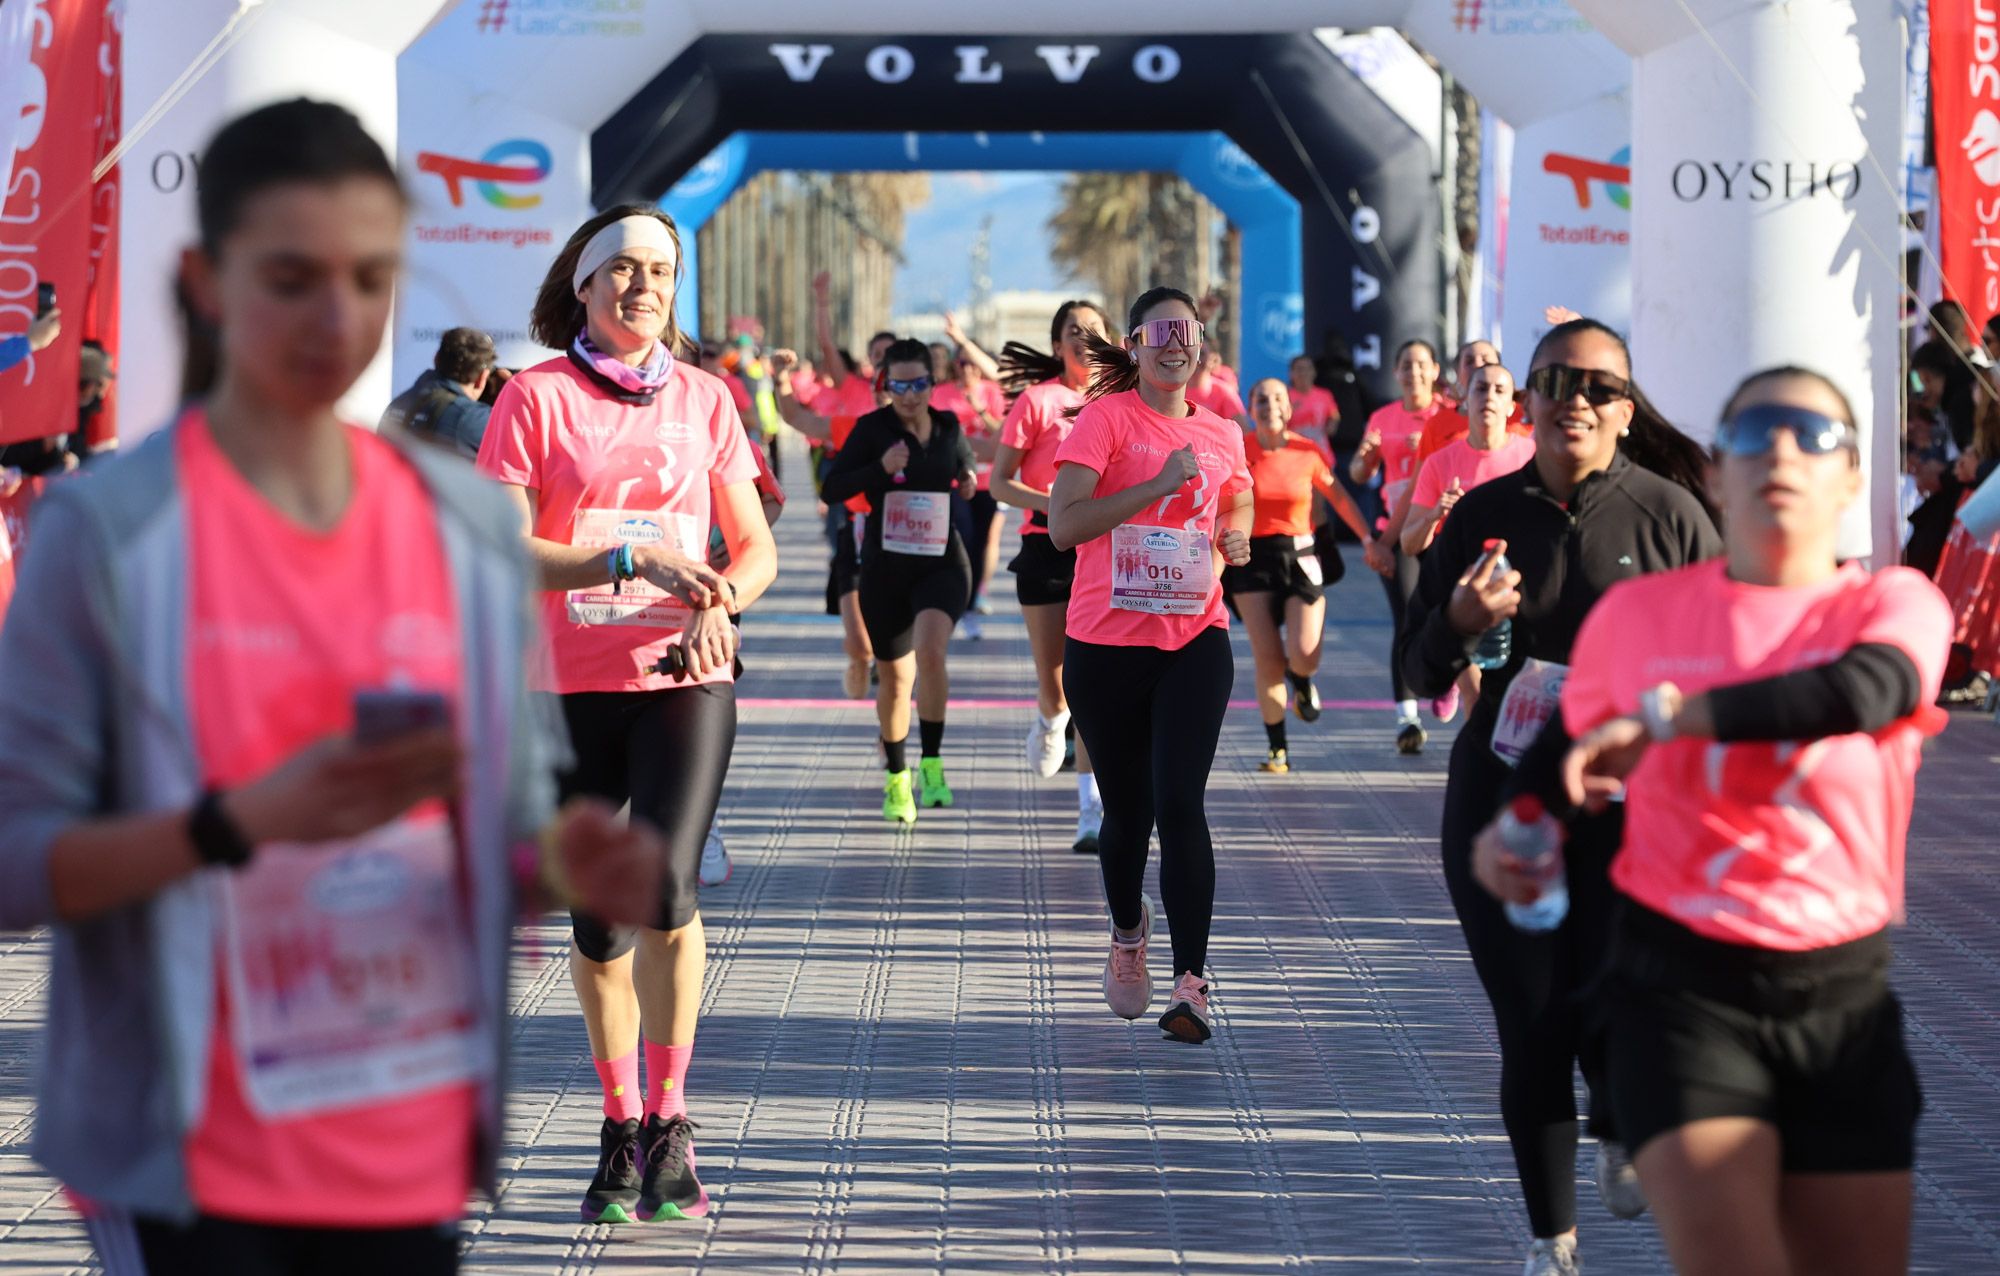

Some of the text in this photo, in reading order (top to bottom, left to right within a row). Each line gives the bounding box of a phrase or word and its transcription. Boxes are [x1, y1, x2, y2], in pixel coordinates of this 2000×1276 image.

[769, 44, 1182, 84] VOLVO
[1671, 159, 1862, 202] OYSHO
[416, 224, 553, 249] TotalEnergies
[1539, 223, 1629, 245] TotalEne
[1351, 205, 1381, 370] LVO
[1147, 564, 1183, 580] 016
[624, 585, 646, 594] 2971
[1154, 582, 1172, 591] 3756
[583, 607, 624, 618] OYSHO
[1121, 599, 1152, 608] OYSHO
